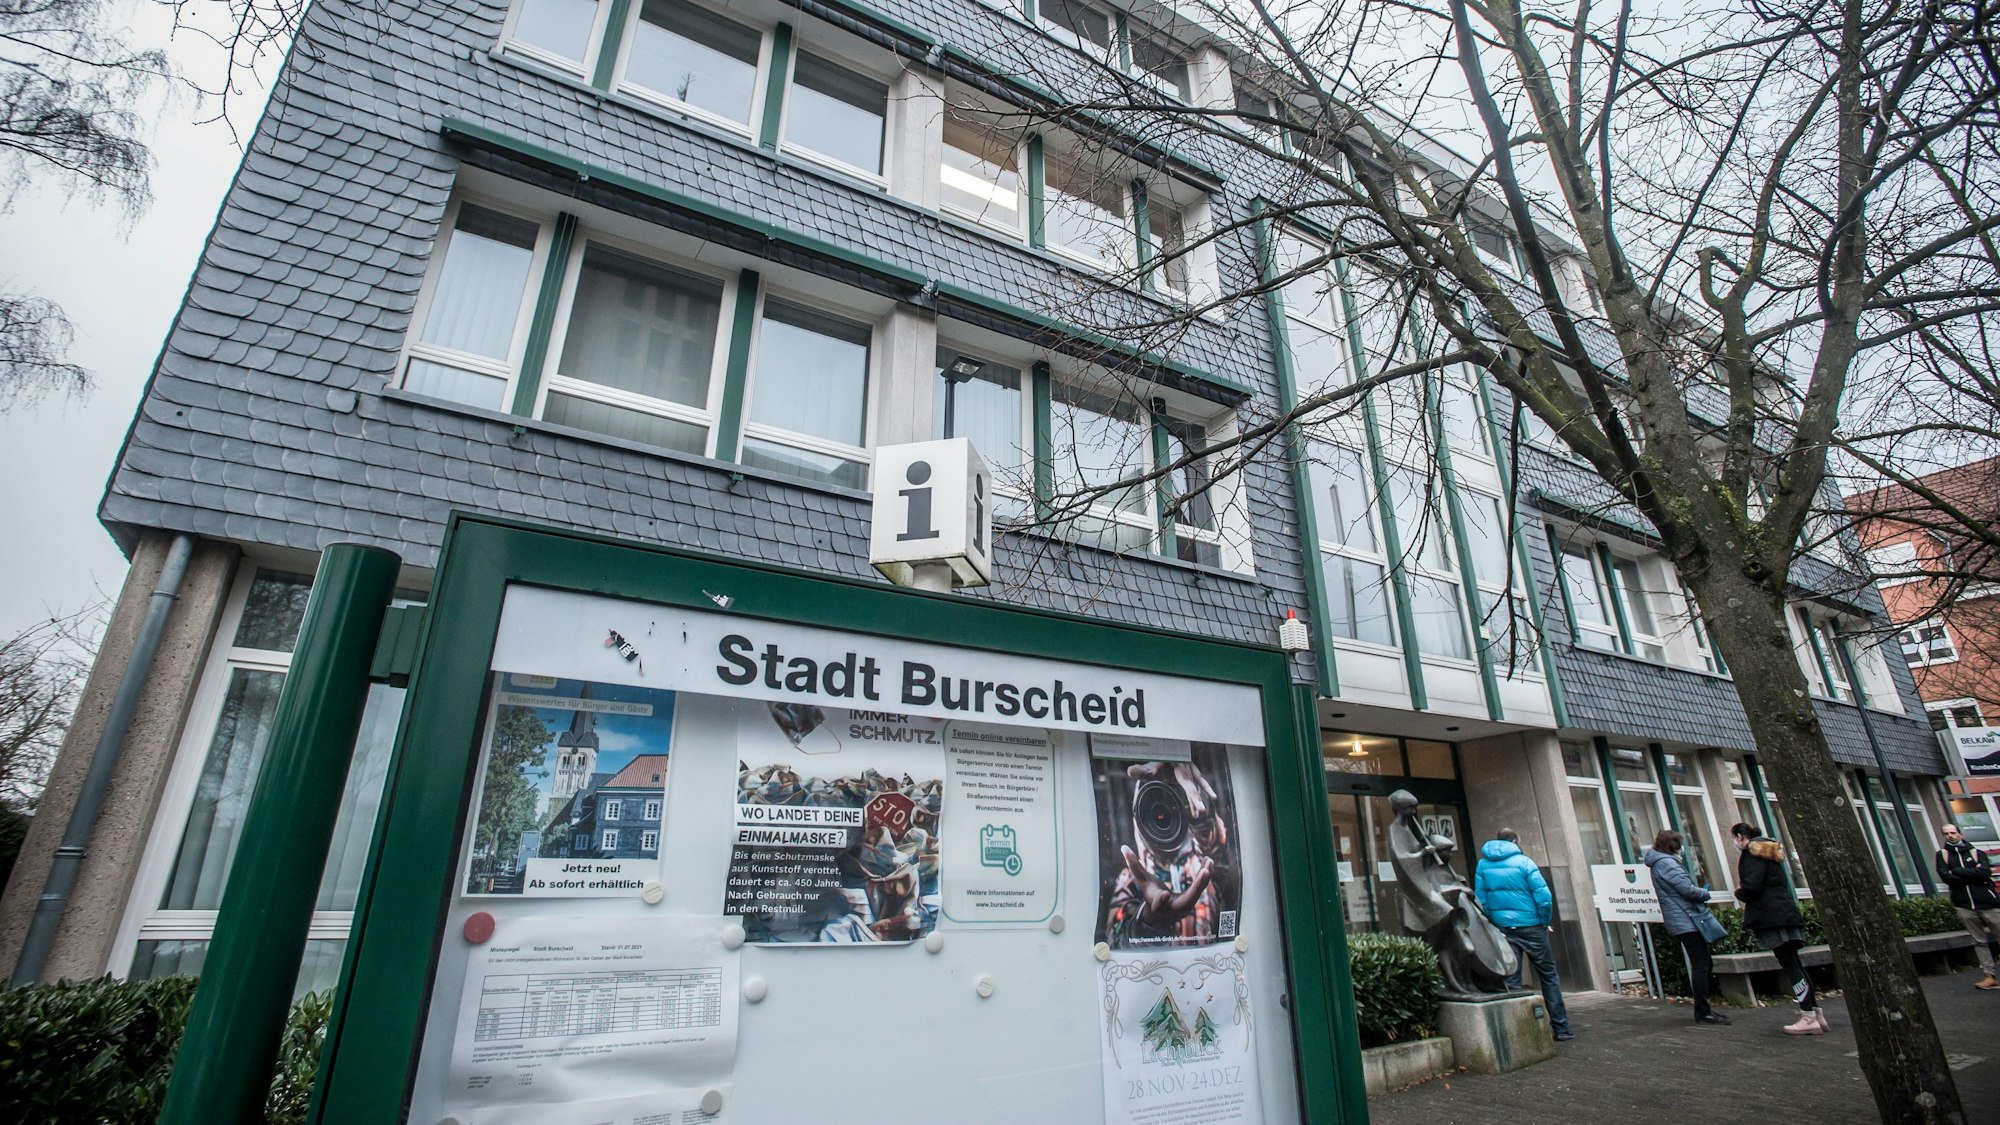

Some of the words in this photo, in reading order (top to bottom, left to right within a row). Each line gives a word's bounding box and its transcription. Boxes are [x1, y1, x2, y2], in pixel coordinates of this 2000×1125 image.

[716, 634, 881, 700] Stadt
[901, 661, 1147, 728] Burscheid
[507, 694, 566, 707] Wissenswertes
[568, 699, 579, 708] für
[582, 700, 607, 712] Bürger
[610, 703, 625, 712] und
[627, 703, 648, 714] Gäste
[849, 709, 909, 724] IMMER
[849, 724, 941, 745] SCHMUTZ.
[952, 729, 978, 739] Termin
[980, 733, 1003, 741] online
[1004, 735, 1047, 745] vereinbaren
[976, 749, 995, 757] können
[957, 758, 993, 767] Bürgerservice
[956, 770, 988, 778] vereinbaren.
[1007, 784, 1035, 792] Bürgerbüro
[966, 792, 1018, 801] Straßenverkehrsamt
[741, 806, 764, 820] WO
[768, 808, 820, 822] LANDET
[824, 810, 860, 823] DEINE
[738, 830, 844, 845] EINMALMASKE?
[986, 838, 1010, 846] Termin
[734, 851, 749, 860] Bis
[751, 852, 771, 861] eine
[774, 852, 835, 862] Schutzmaske
[561, 863, 592, 873] Jetzt
[596, 864, 621, 873] neu!
[731, 865, 748, 873] aus
[751, 865, 801, 874] Kunststoff
[803, 866, 842, 876] verottet,
[529, 879, 546, 889] Ab
[549, 879, 585, 889] sofort
[588, 879, 644, 889] erhältlich
[729, 877, 761, 887] dauert
[764, 879, 776, 887] es
[795, 879, 812, 888] 450
[814, 879, 842, 888] Jahre.
[728, 891, 753, 900] Nach
[756, 891, 801, 901] Gebrauch
[804, 892, 820, 900] nur
[727, 904, 737, 913] in
[739, 904, 758, 913] den
[761, 904, 806, 914] Restmüll.
